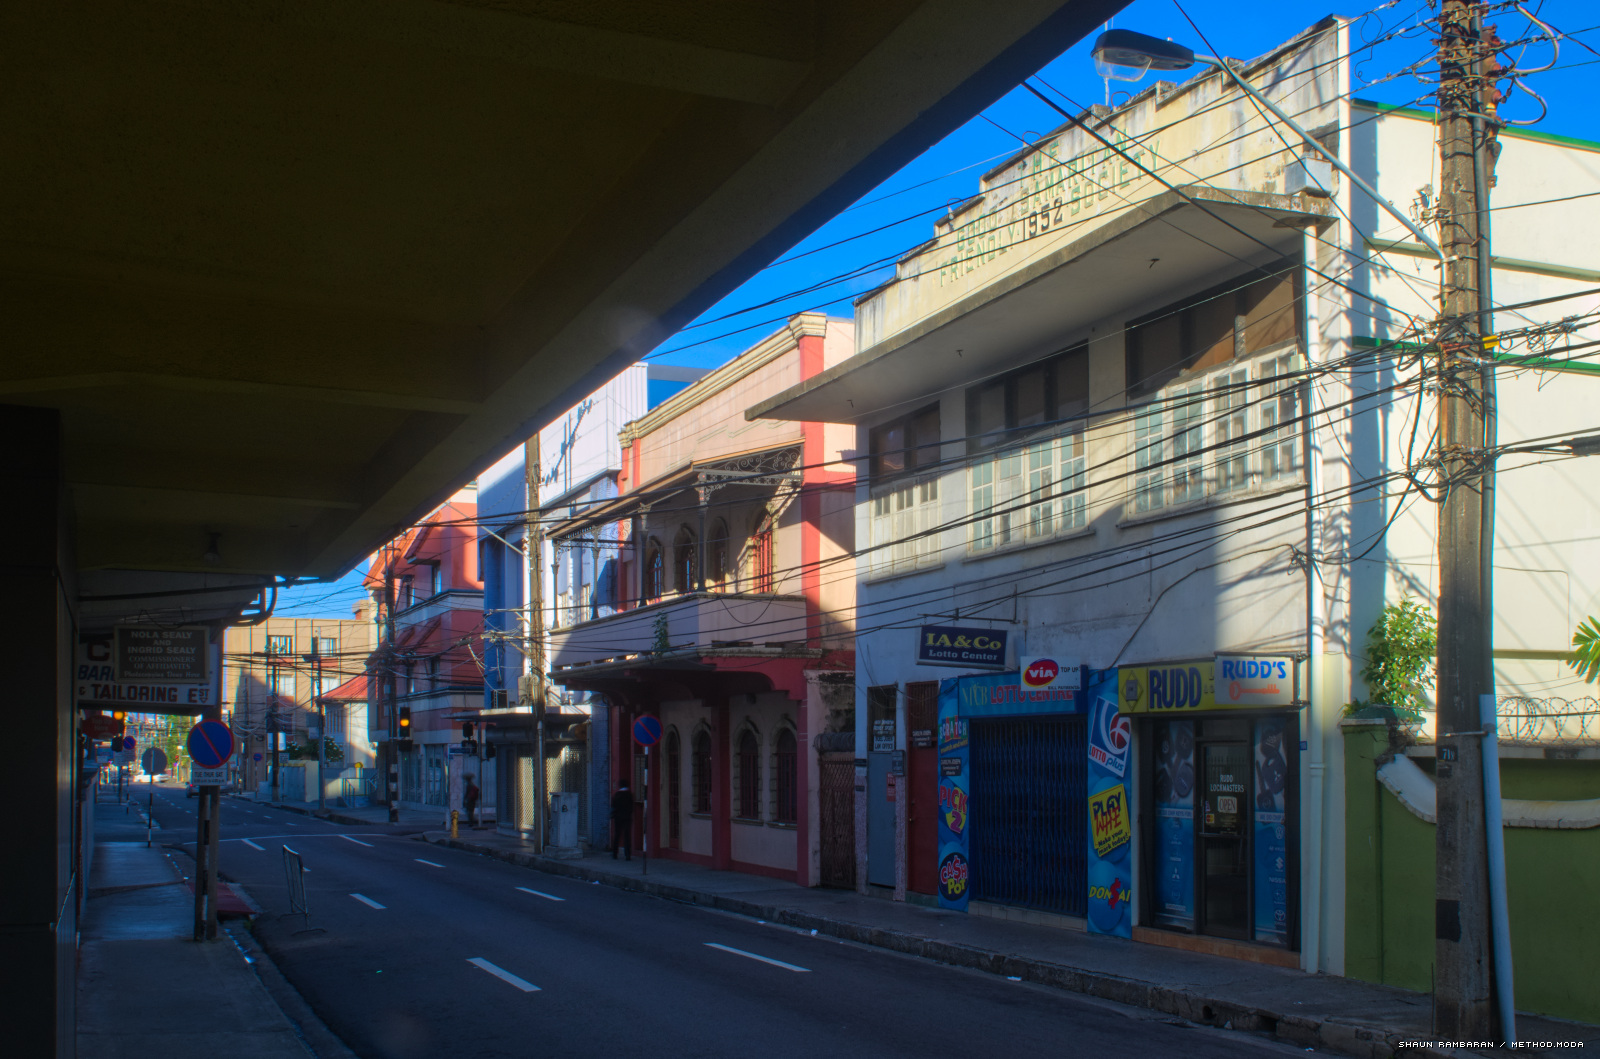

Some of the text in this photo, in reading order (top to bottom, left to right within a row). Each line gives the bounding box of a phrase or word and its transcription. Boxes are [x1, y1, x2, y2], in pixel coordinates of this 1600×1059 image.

[1018, 138, 1061, 189] THE
[1020, 128, 1128, 216] SAMARITAN
[940, 140, 1161, 287] FRIENDLY 1952 SOCIETY
[131, 631, 193, 639] NOLA SEALY
[926, 632, 1001, 650] IA&Co
[127, 646, 196, 654] INGRID SEALY
[128, 655, 196, 663] COMMISSIONERS
[929, 649, 998, 661] Lotto Center
[1222, 660, 1286, 680] RUDD'S
[91, 683, 178, 702] TAILORING
[990, 684, 1026, 705] LOTTO
[1150, 666, 1202, 709] RUDD
[939, 720, 967, 740] SCRATCH
[1088, 744, 1124, 772] LOTTO plus
[1210, 783, 1244, 793] LOCKMASTERS
[1220, 774, 1234, 783] RUDD
[939, 785, 968, 815] PICK
[1092, 791, 1122, 820] PLAY
[1218, 798, 1236, 811] OPEN
[950, 810, 962, 834] 2
[947, 877, 966, 895] POT
